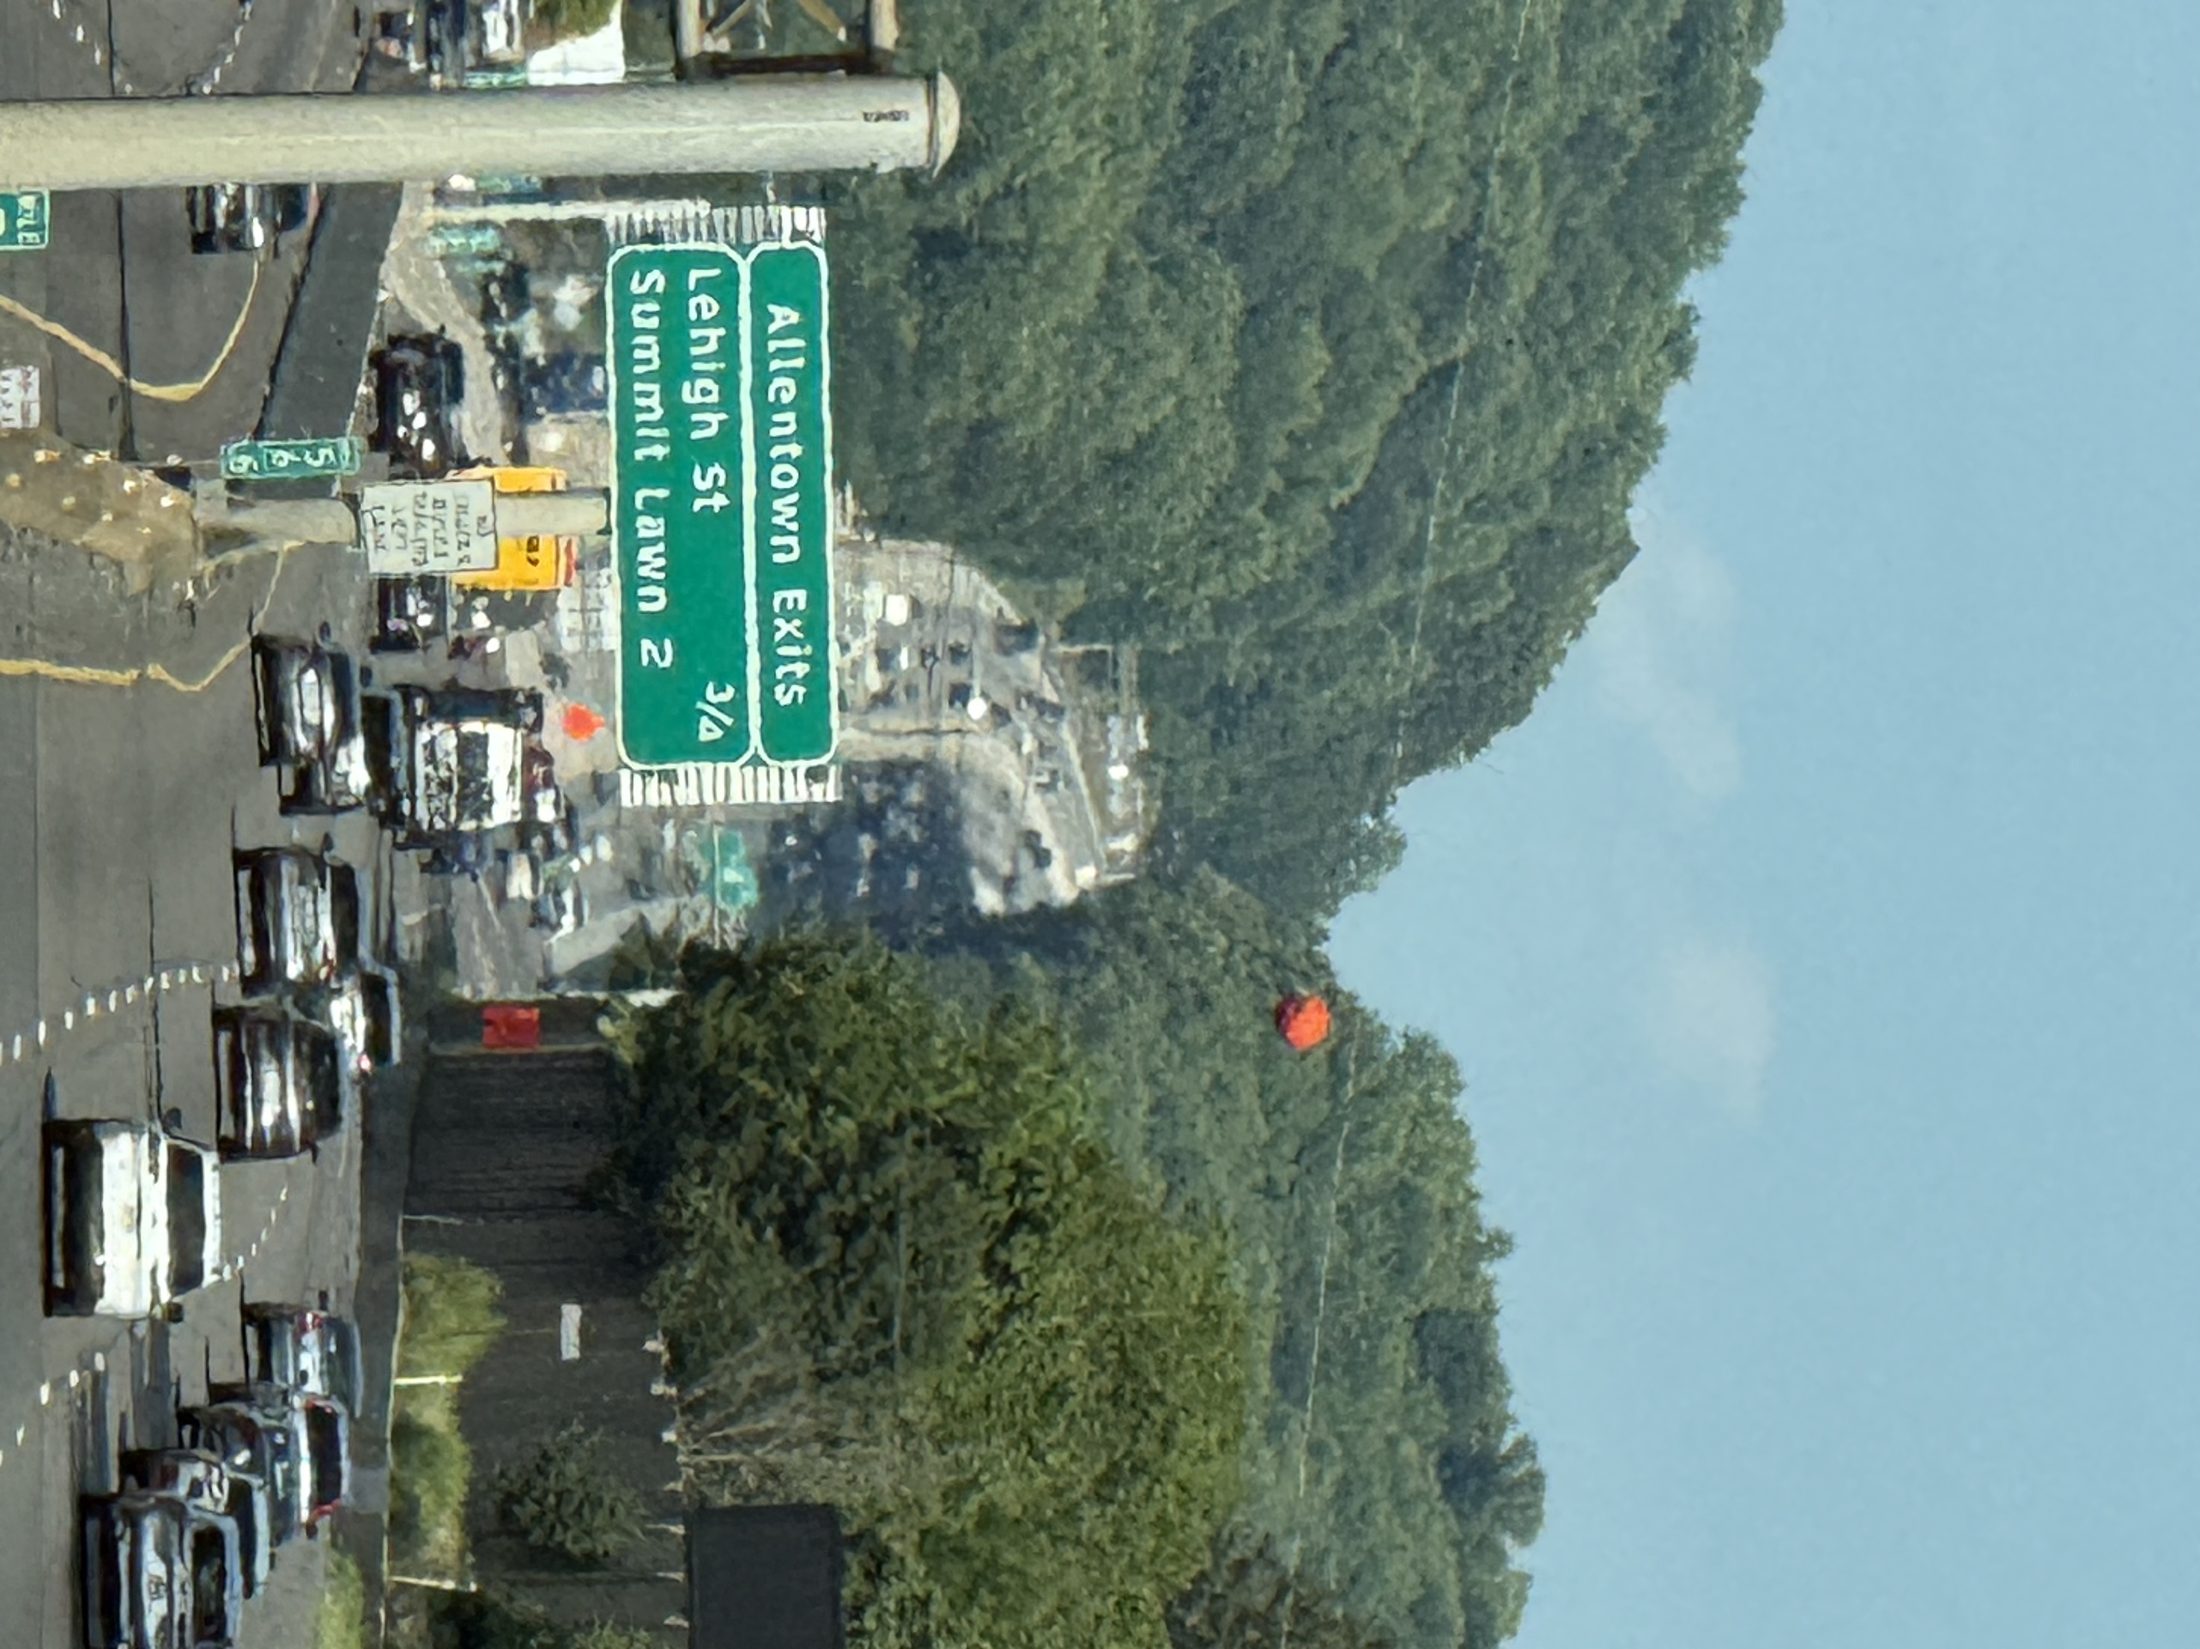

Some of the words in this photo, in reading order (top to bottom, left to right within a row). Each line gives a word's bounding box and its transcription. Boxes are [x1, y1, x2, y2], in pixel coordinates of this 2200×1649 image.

[630, 269, 670, 461] Summit
[681, 268, 730, 441] Lehigh
[692, 462, 730, 513] St
[767, 304, 804, 564] Allentown
[634, 488, 670, 612] Lawn
[640, 638, 673, 668] 2
[772, 590, 813, 707] Exits
[695, 681, 735, 742] 3/4
